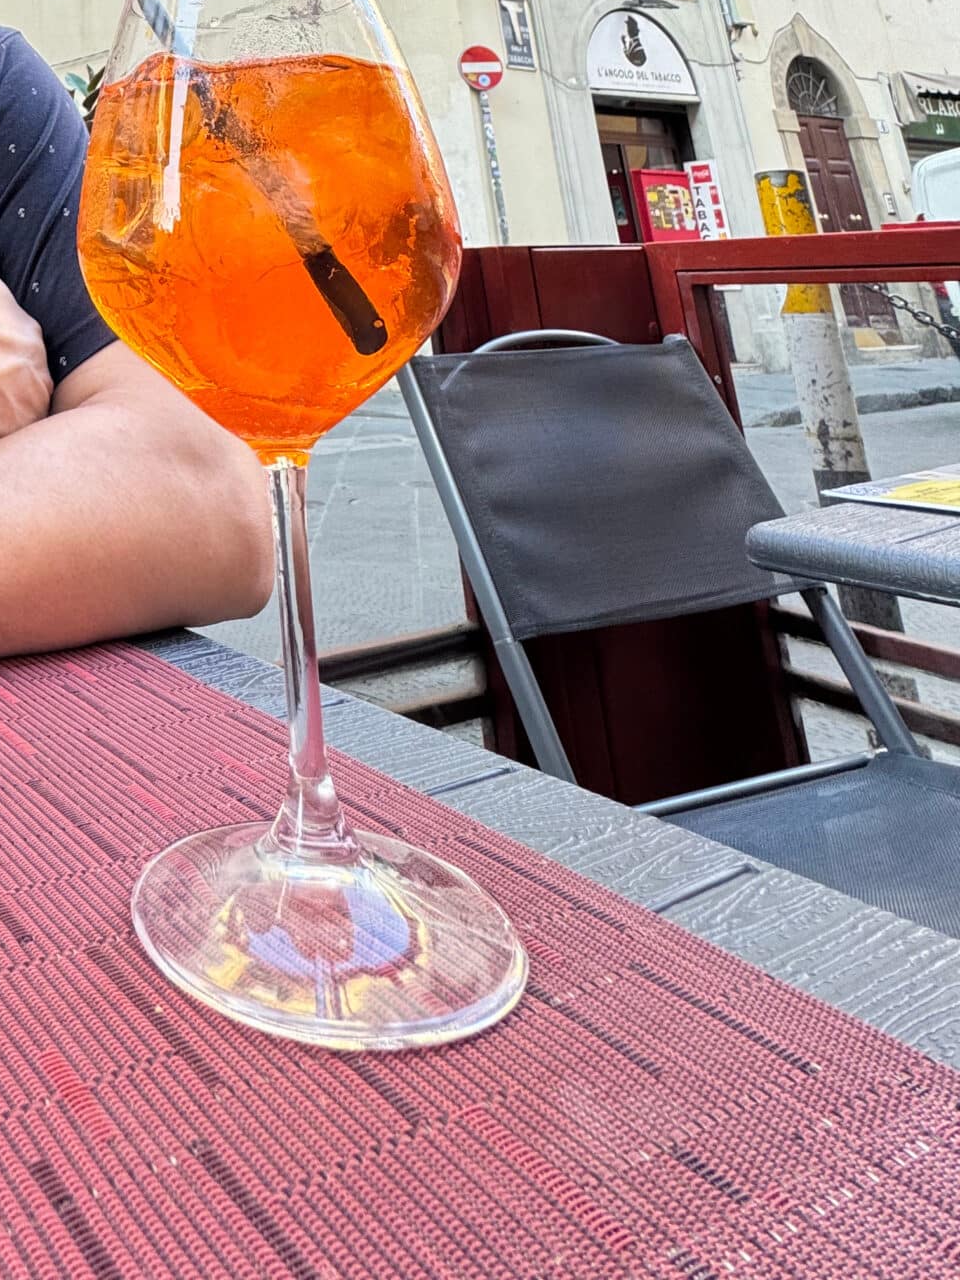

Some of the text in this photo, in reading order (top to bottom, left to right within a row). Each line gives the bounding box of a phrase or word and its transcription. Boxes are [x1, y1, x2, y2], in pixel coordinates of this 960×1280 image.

[597, 66, 682, 84] L'ANGOLO DEL TABACCO
